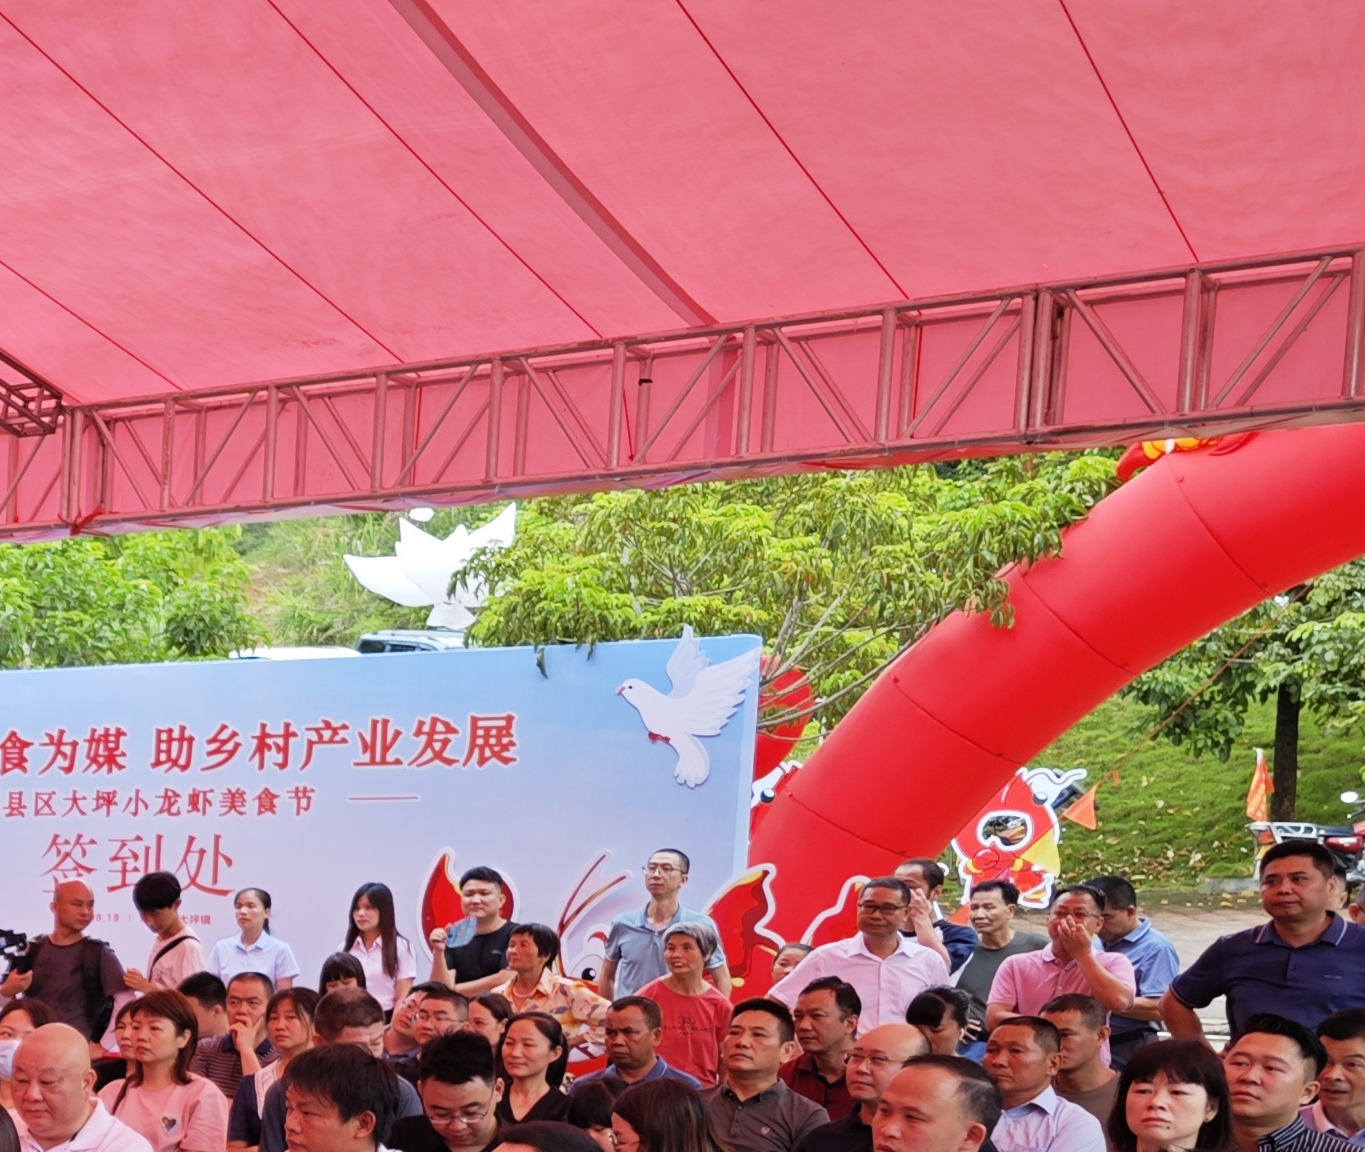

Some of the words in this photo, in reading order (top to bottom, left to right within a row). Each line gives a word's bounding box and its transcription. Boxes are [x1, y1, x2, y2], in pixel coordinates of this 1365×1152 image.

[150, 713, 518, 774] 助乡村产业发展
[40, 832, 236, 898] 签到处
